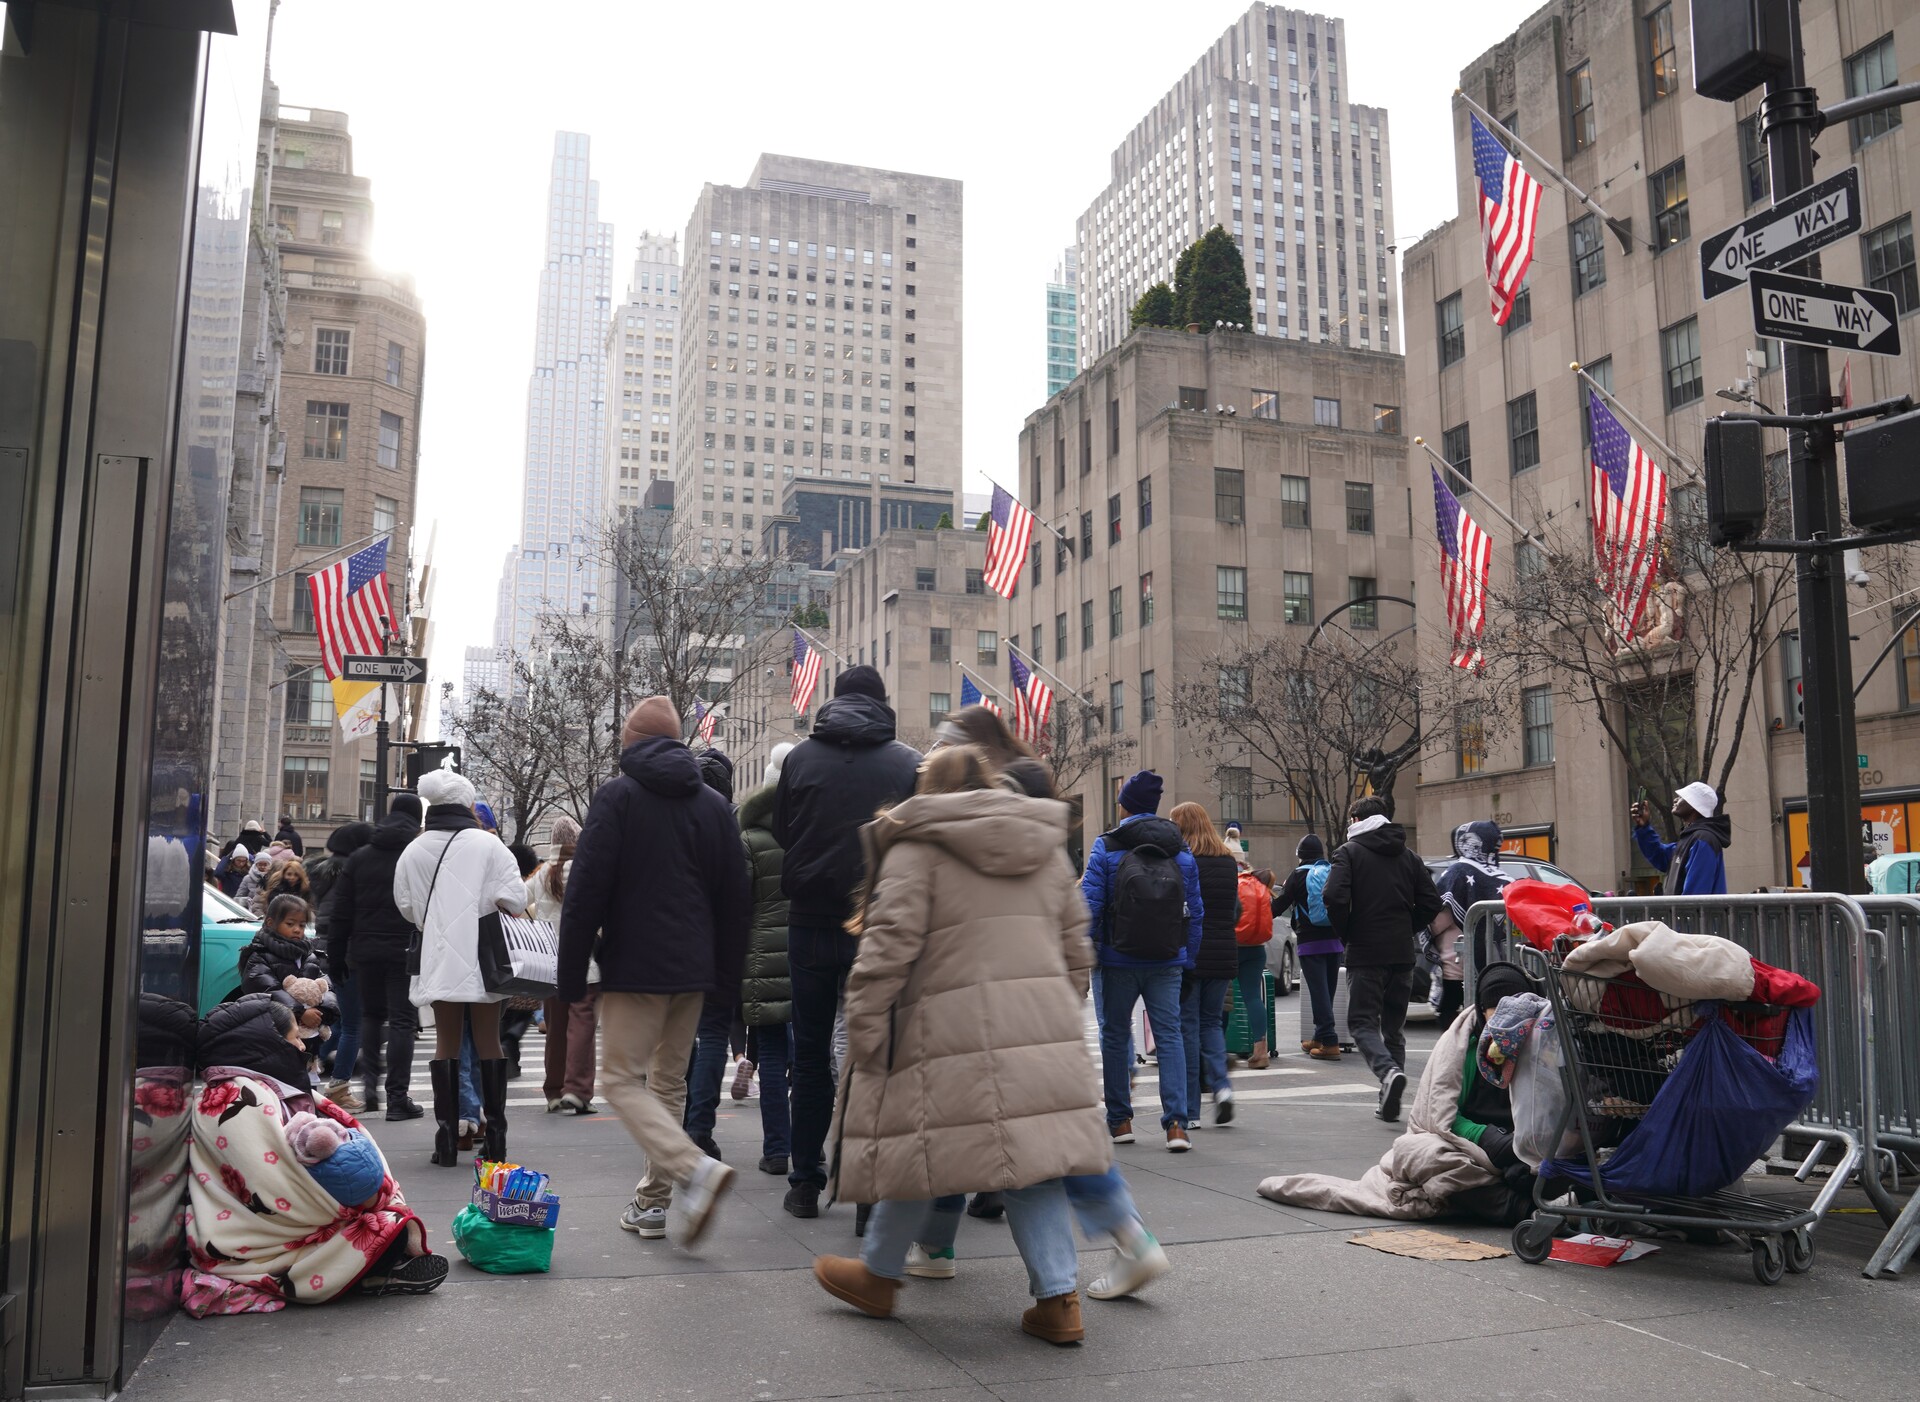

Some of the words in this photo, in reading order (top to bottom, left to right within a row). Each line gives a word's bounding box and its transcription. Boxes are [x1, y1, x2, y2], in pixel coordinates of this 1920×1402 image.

[1725, 232, 1766, 270] ONE
[1794, 194, 1841, 237] WAY
[1768, 293, 1809, 322] ONE
[1834, 303, 1874, 333] WAY
[355, 663, 379, 674] ONE
[390, 665, 414, 676] WAY
[499, 1204, 529, 1216] Welch's
